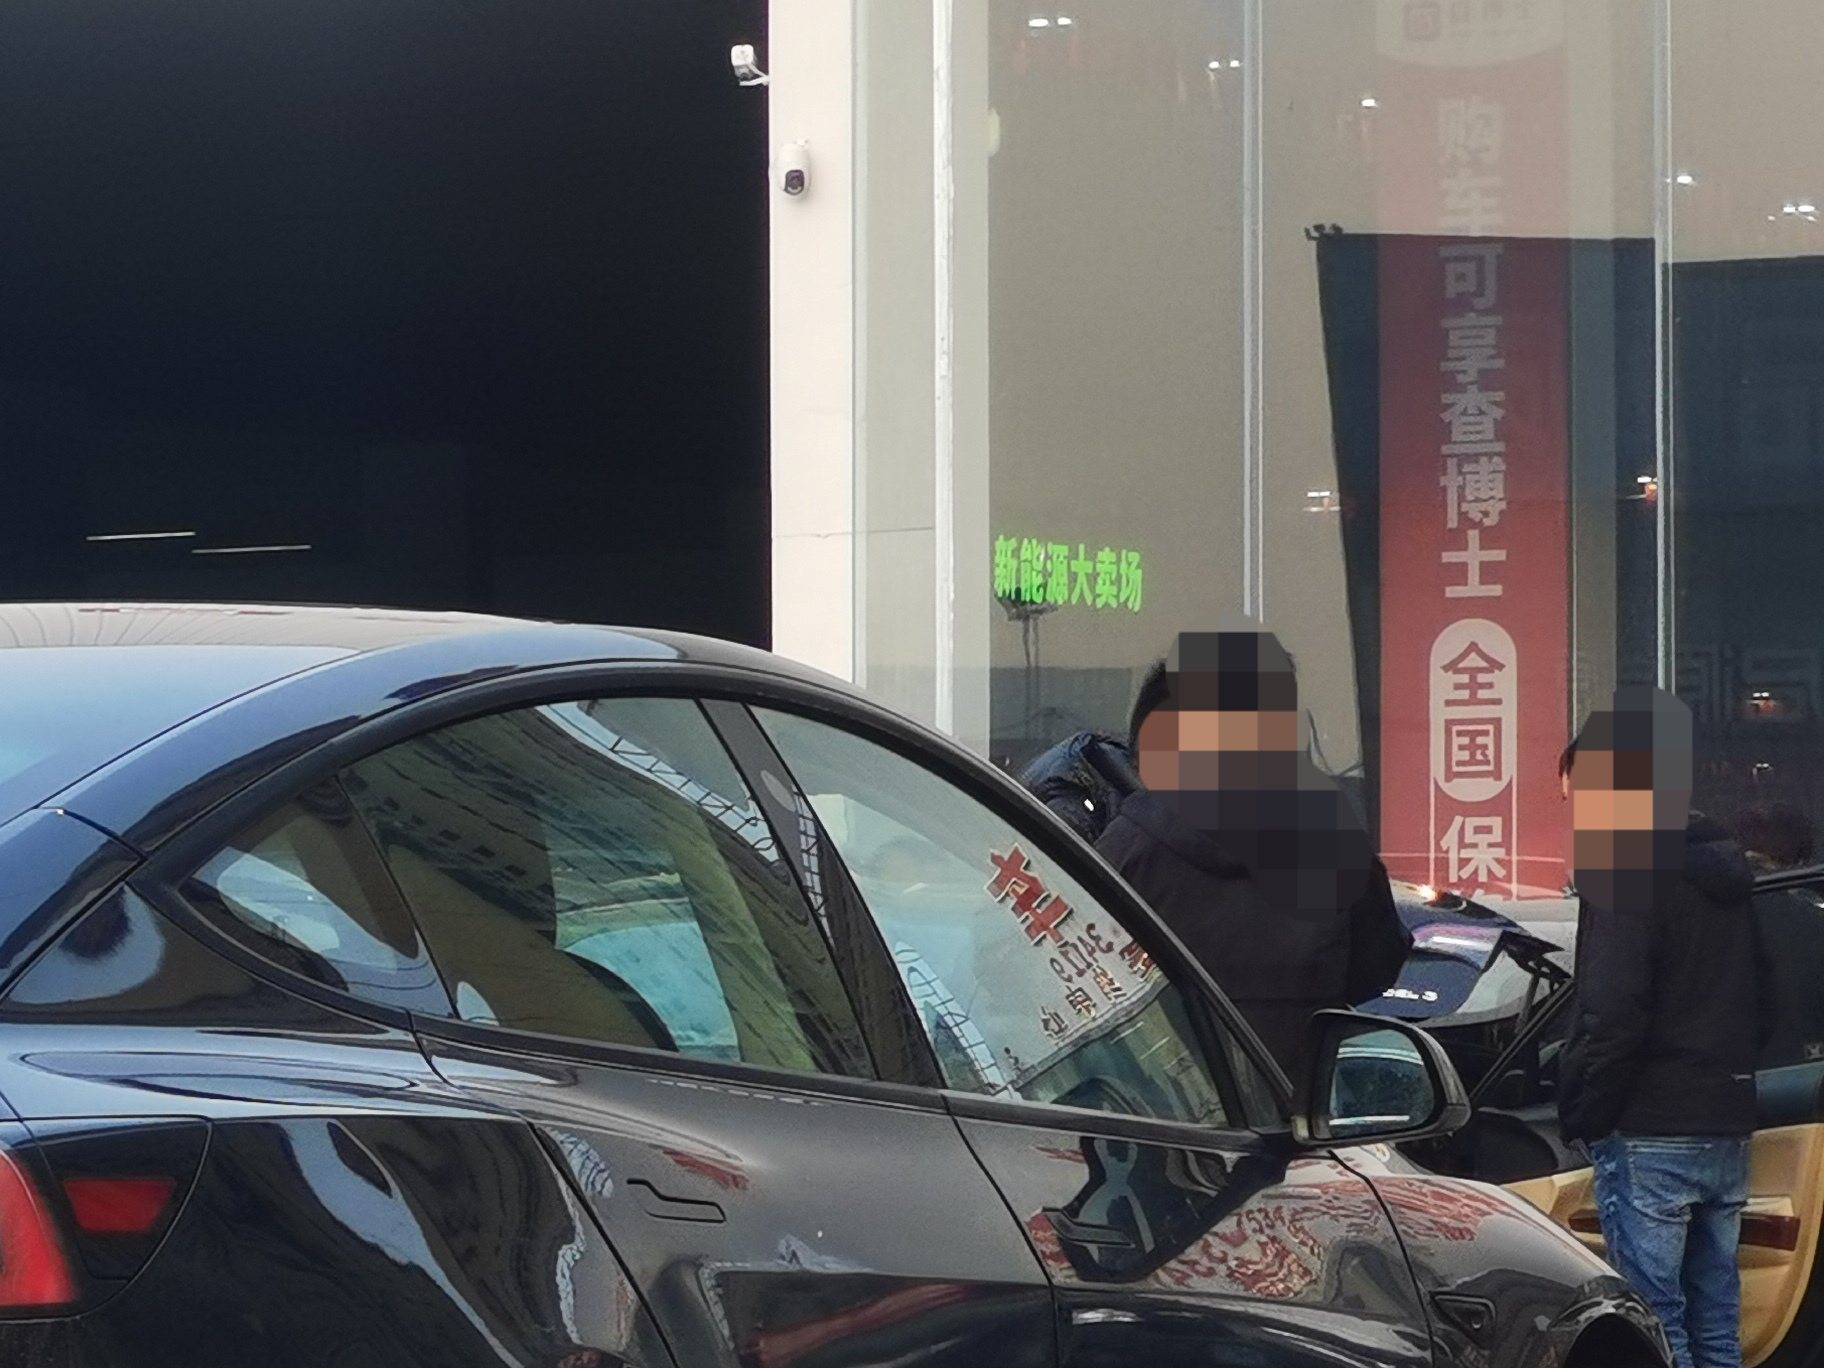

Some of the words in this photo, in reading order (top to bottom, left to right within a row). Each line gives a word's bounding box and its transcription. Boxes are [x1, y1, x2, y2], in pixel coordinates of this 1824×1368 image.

[1438, 96, 1508, 600] 购车可享查博士
[993, 534, 1143, 613] 新能源大卖场
[1440, 640, 1507, 783] 全国
